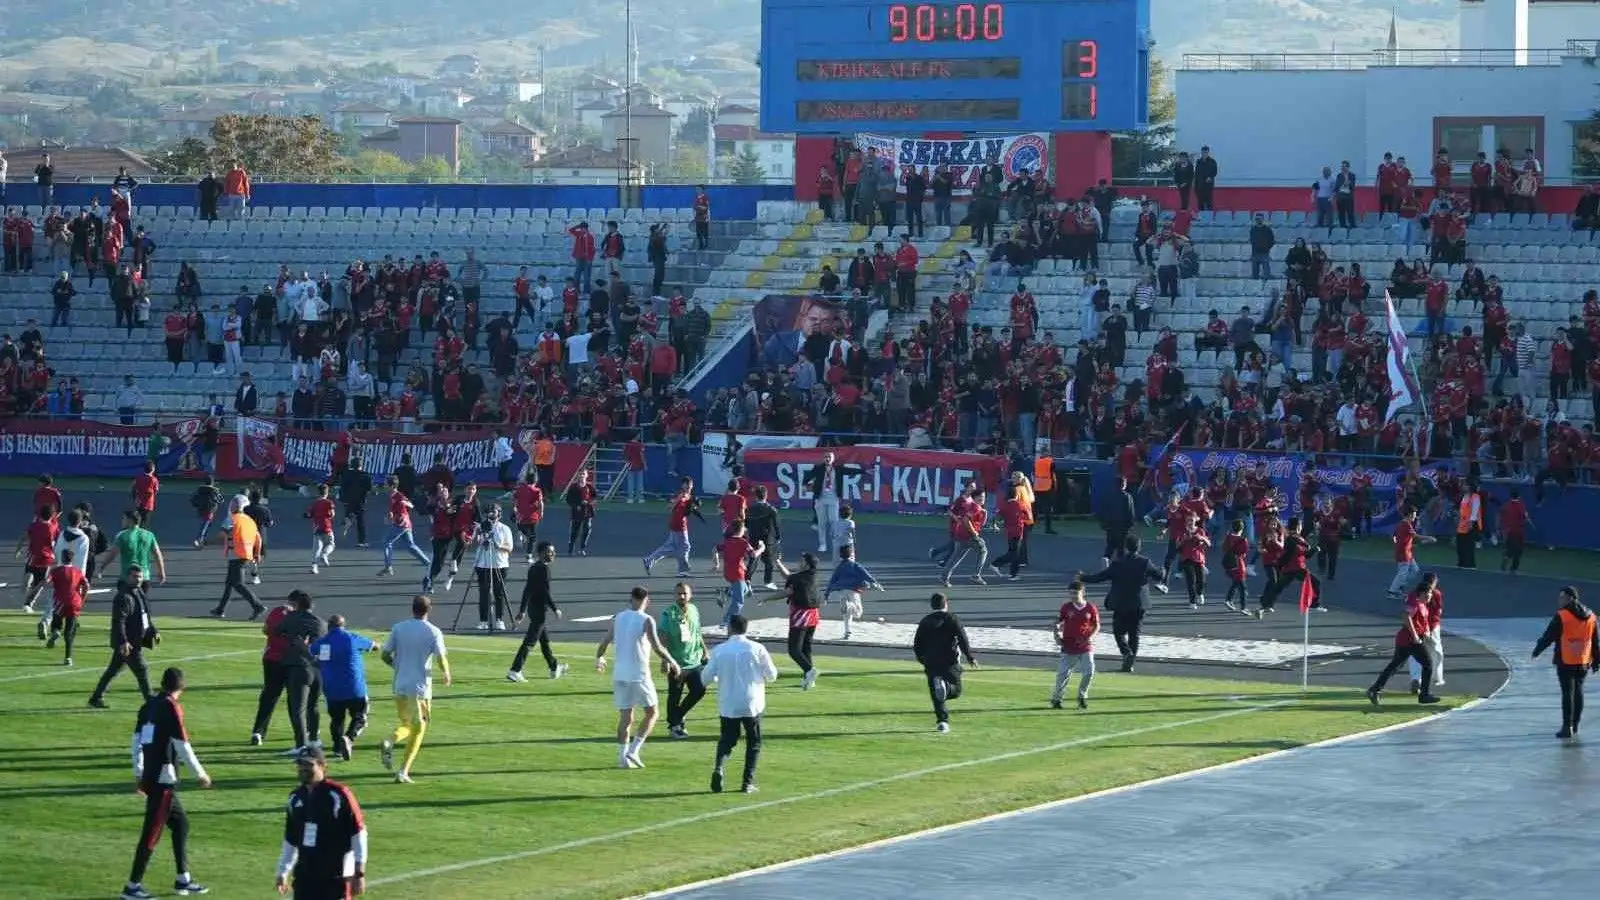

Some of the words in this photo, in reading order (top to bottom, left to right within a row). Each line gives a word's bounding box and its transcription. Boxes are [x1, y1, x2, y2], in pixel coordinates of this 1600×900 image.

[889, 4, 1003, 41] 90:00
[1079, 40, 1097, 78] 3
[1089, 84, 1097, 118] 1
[899, 138, 1004, 165] SERKAN
[88, 430, 125, 456] BİZİM
[776, 456, 881, 510] ŞER-İ
